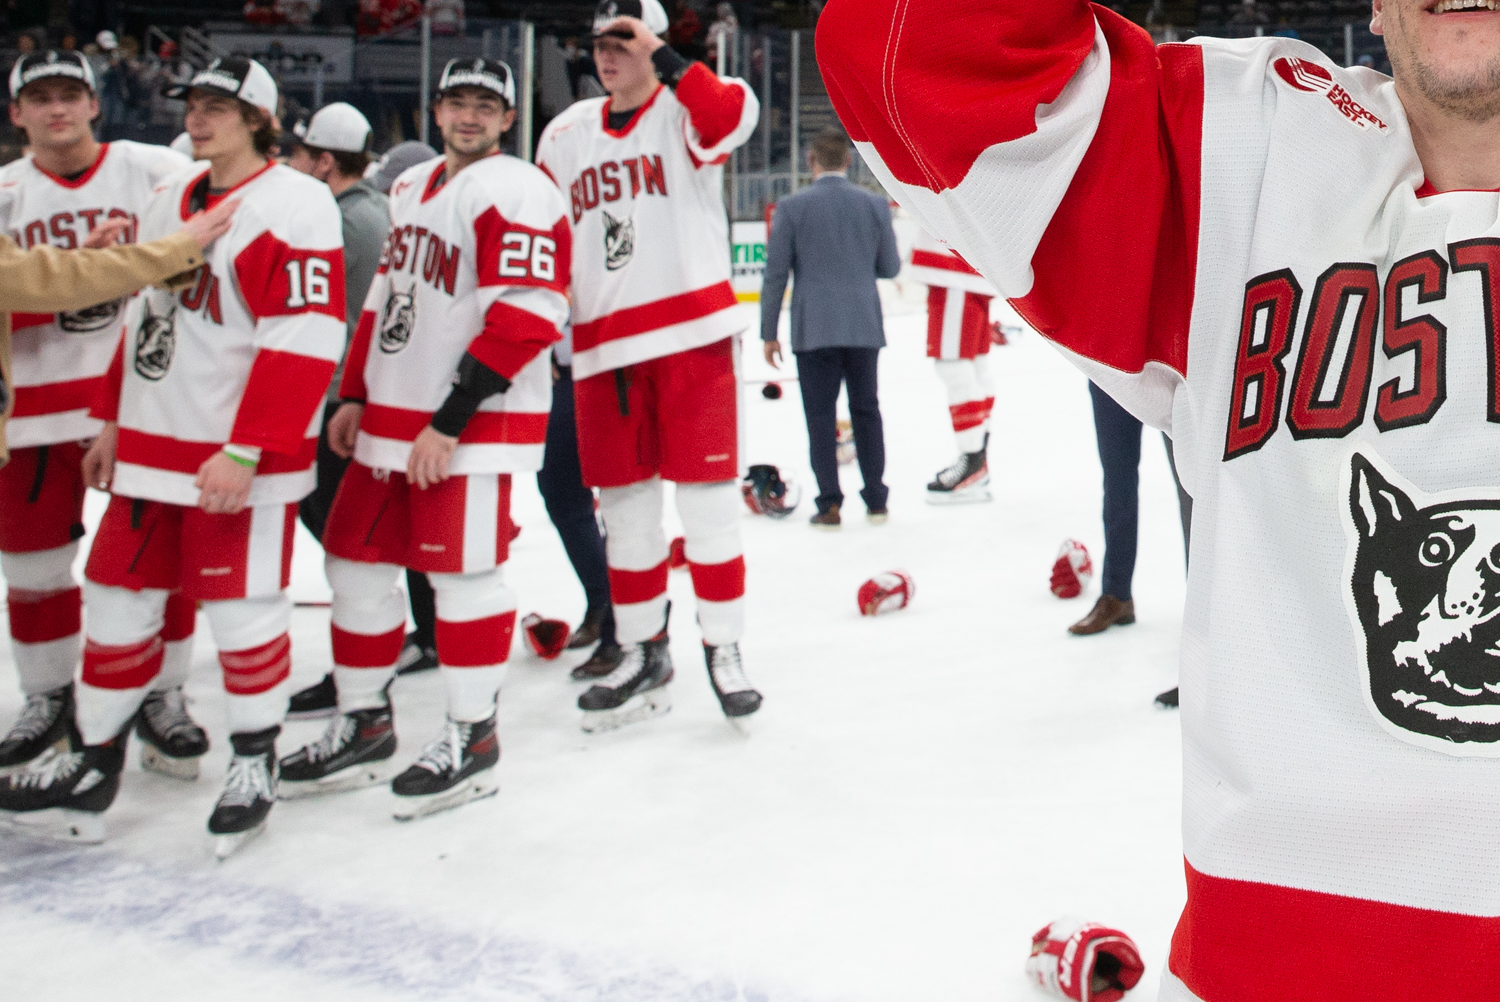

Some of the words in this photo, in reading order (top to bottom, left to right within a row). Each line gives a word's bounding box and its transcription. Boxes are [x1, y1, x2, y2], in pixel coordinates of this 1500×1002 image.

[1326, 89, 1362, 122] EAST
[1332, 83, 1388, 129] HOCKEY
[498, 230, 557, 282] 26
[285, 256, 331, 309] 16
